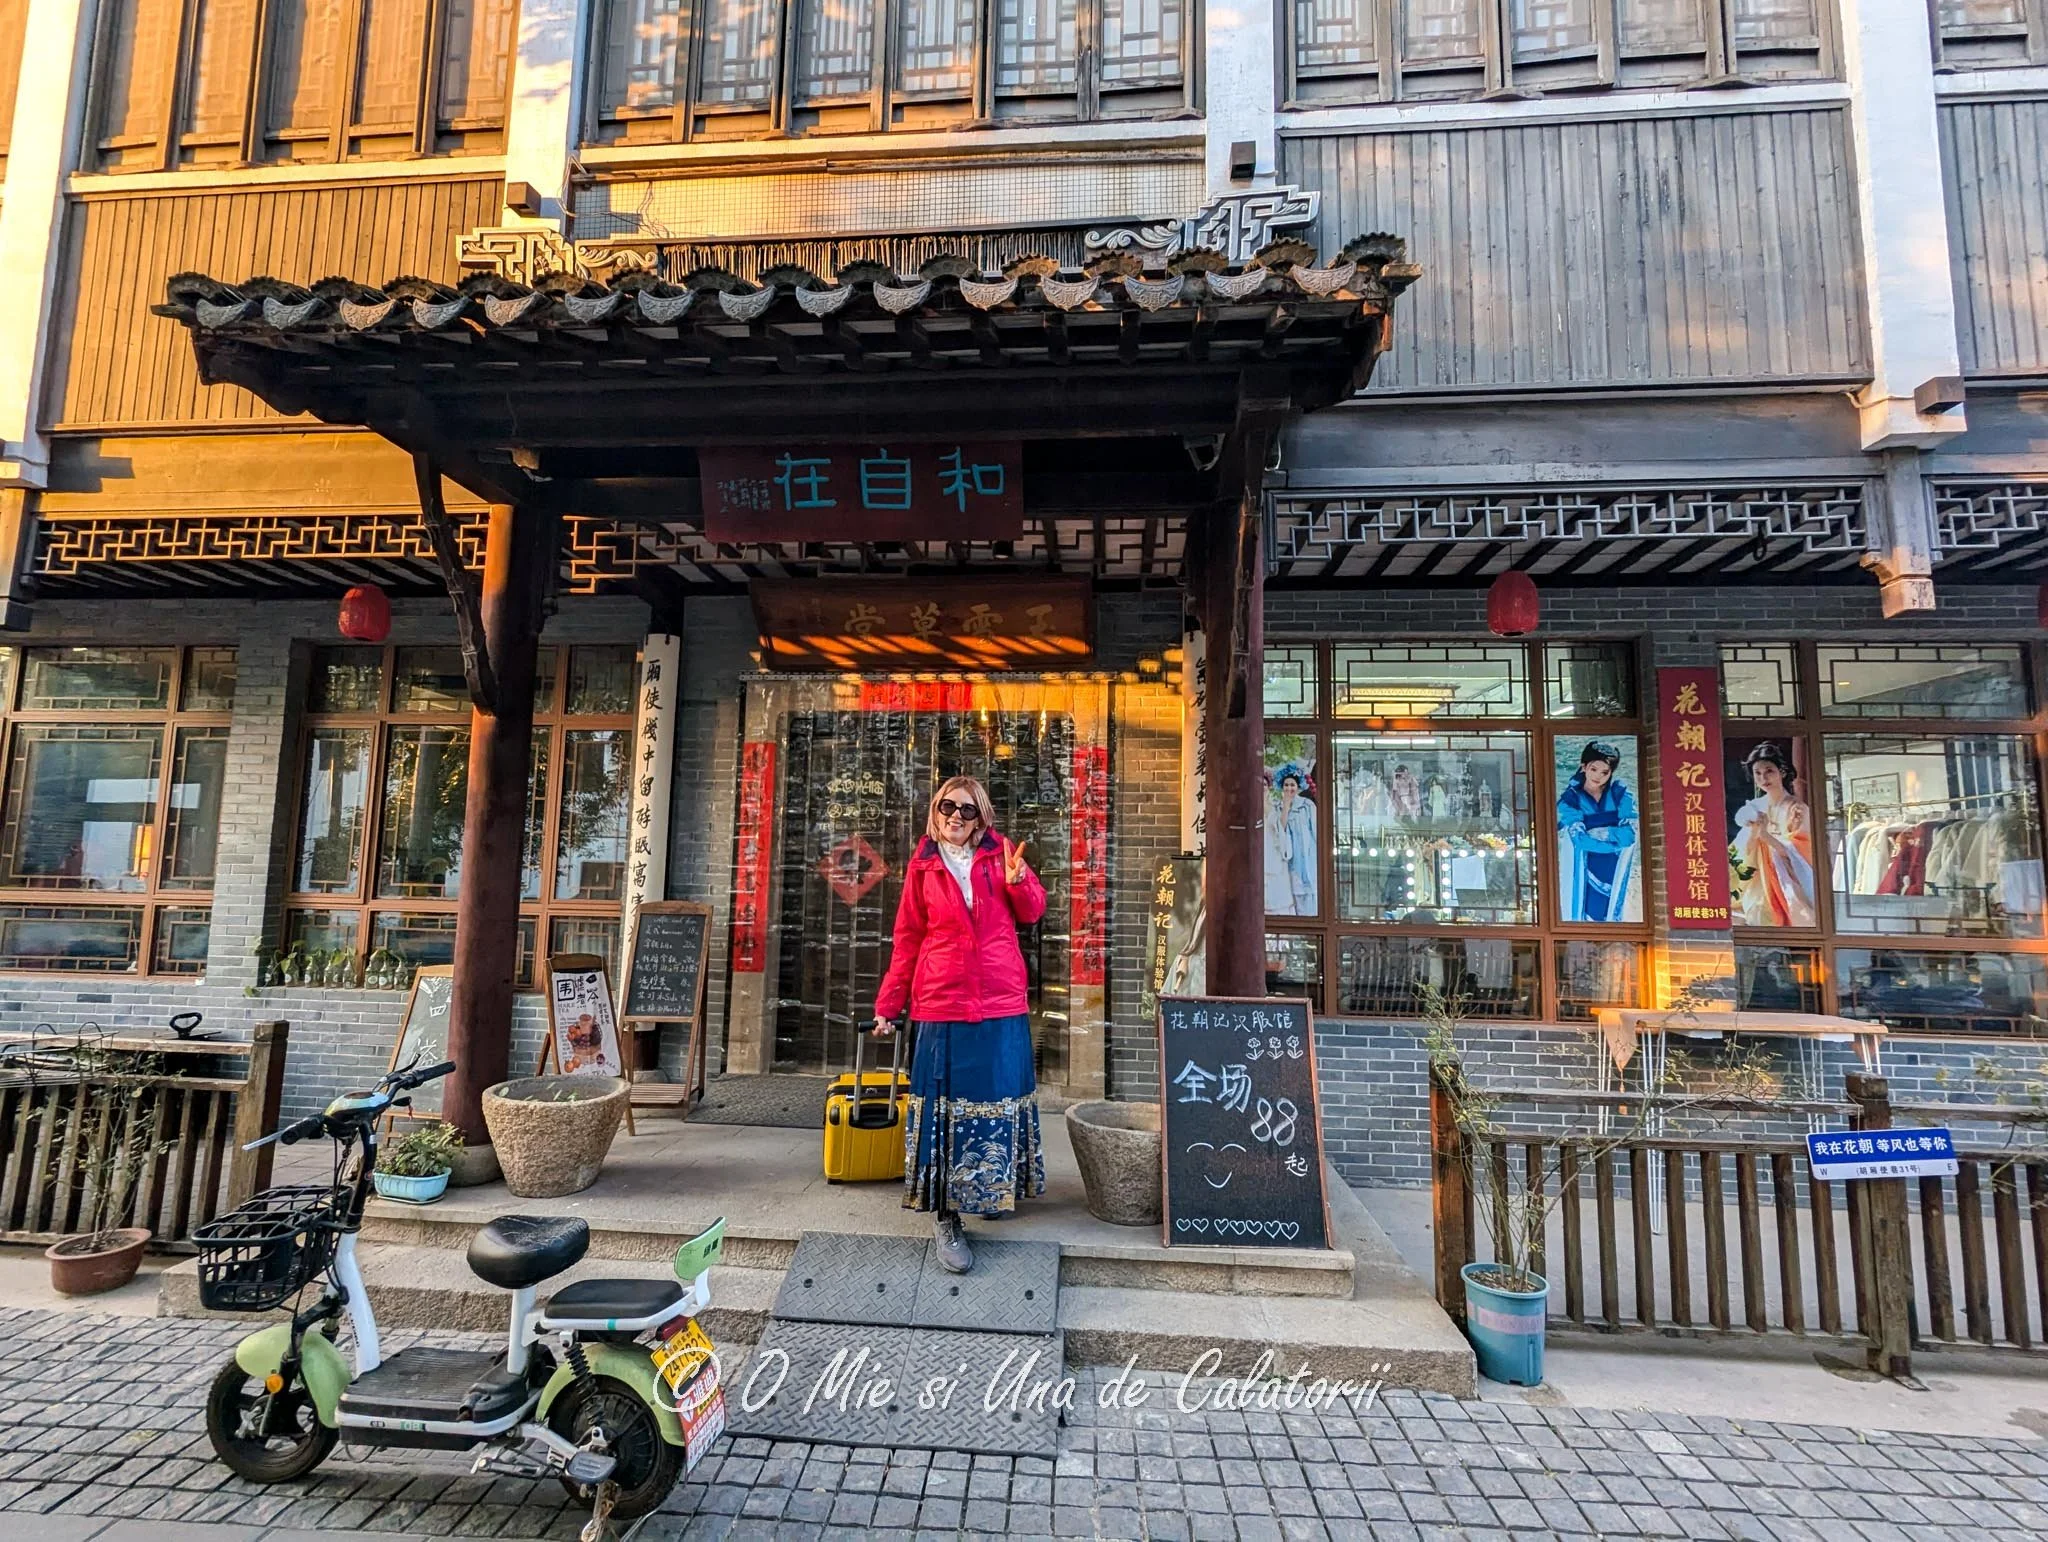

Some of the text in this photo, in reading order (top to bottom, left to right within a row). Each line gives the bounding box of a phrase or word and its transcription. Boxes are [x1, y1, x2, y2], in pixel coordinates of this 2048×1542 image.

[1672, 681, 1711, 901] 花朝记 汉服体验馆
[1674, 907, 1728, 919] 胡厢使巷31号
[1153, 864, 1176, 990] 花朝记 汉服体验馆
[1170, 1010, 1293, 1033] 花朝记汉服馆
[1172, 1059, 1252, 1113] 全场
[1251, 1097, 1299, 1147] 88
[1815, 1136, 1948, 1156] 我在花朝 等风也等你
[1284, 1151, 1308, 1177] 起
[1820, 1168, 1828, 1176] W
[1947, 1162, 1953, 1171] E
